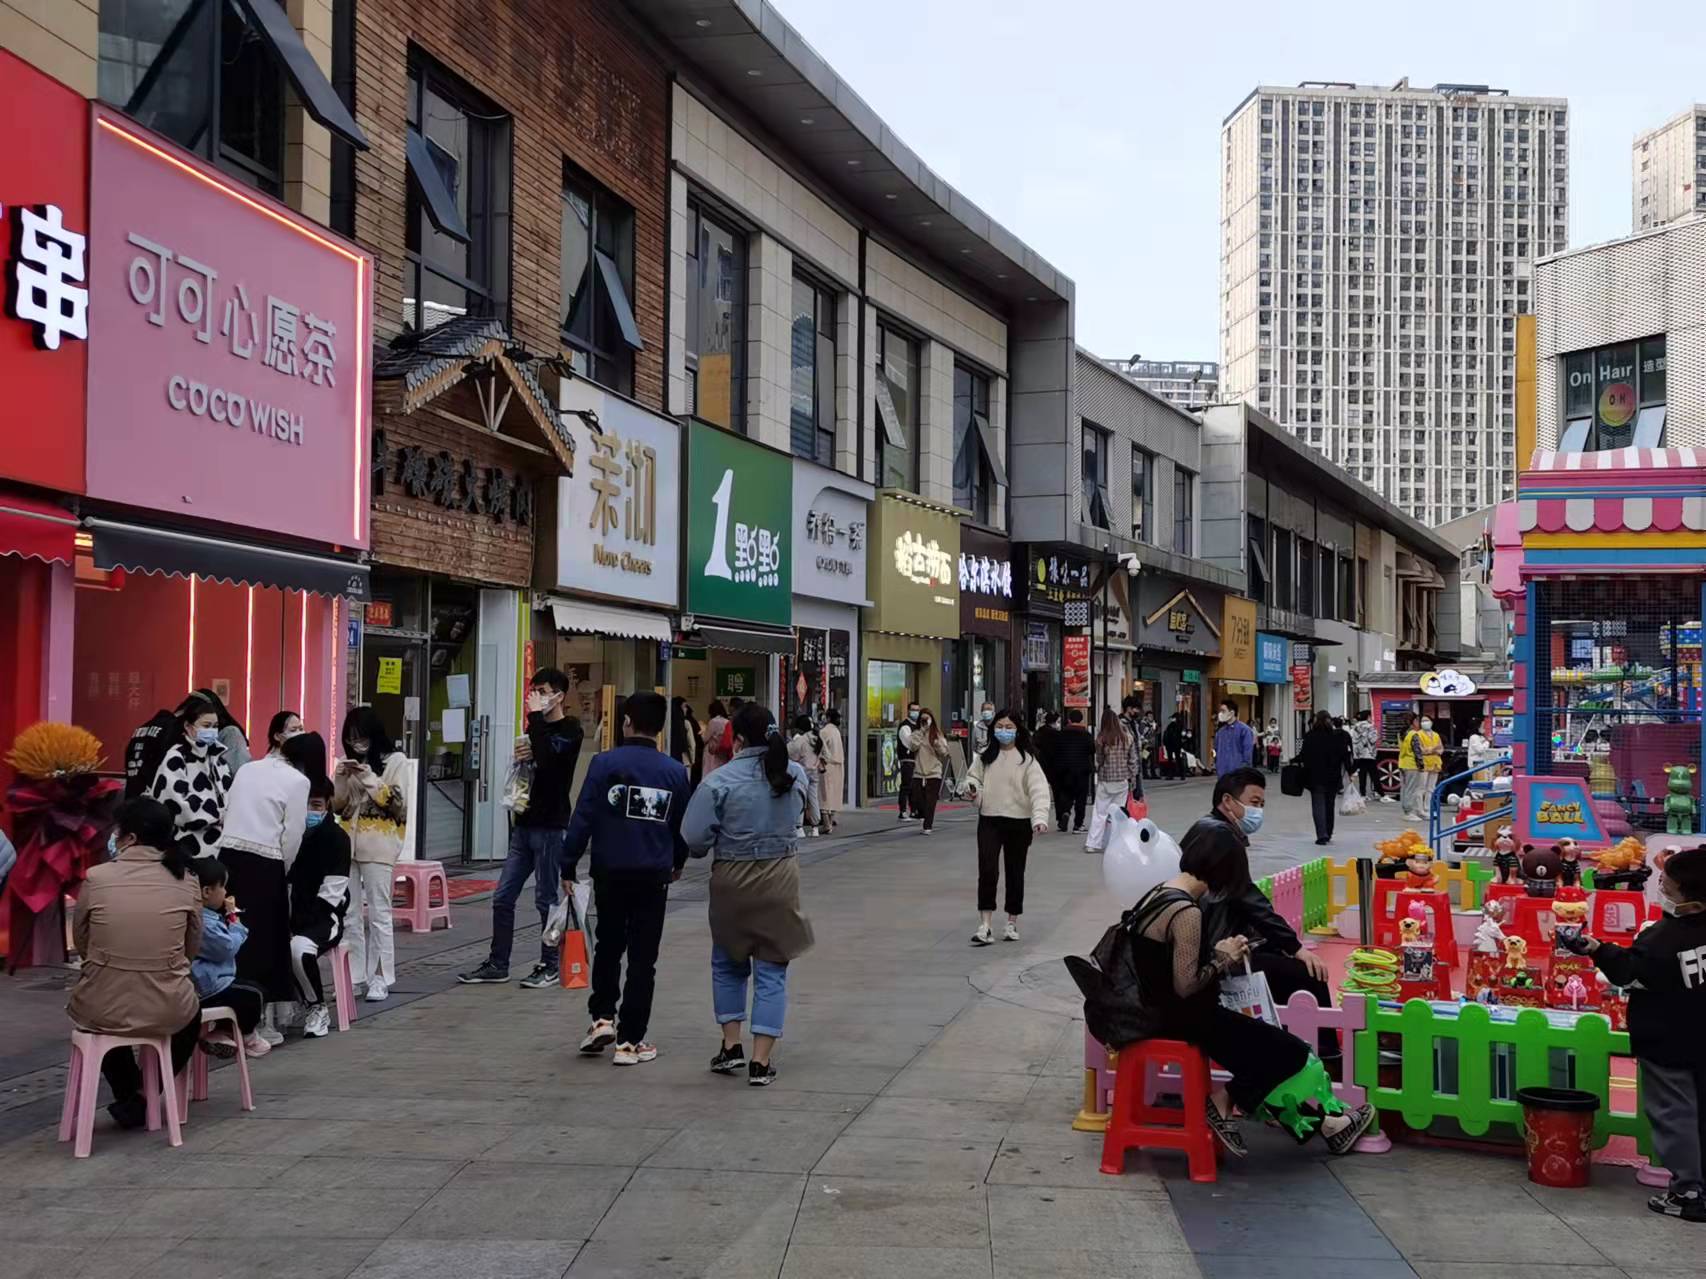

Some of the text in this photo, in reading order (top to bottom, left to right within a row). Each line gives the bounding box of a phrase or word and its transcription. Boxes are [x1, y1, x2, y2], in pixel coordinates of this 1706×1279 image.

[16, 204, 88, 350] 串
[127, 231, 337, 388] 可可心愿茶
[168, 375, 305, 445] COCO WISH
[1570, 365, 1633, 387] On Hair
